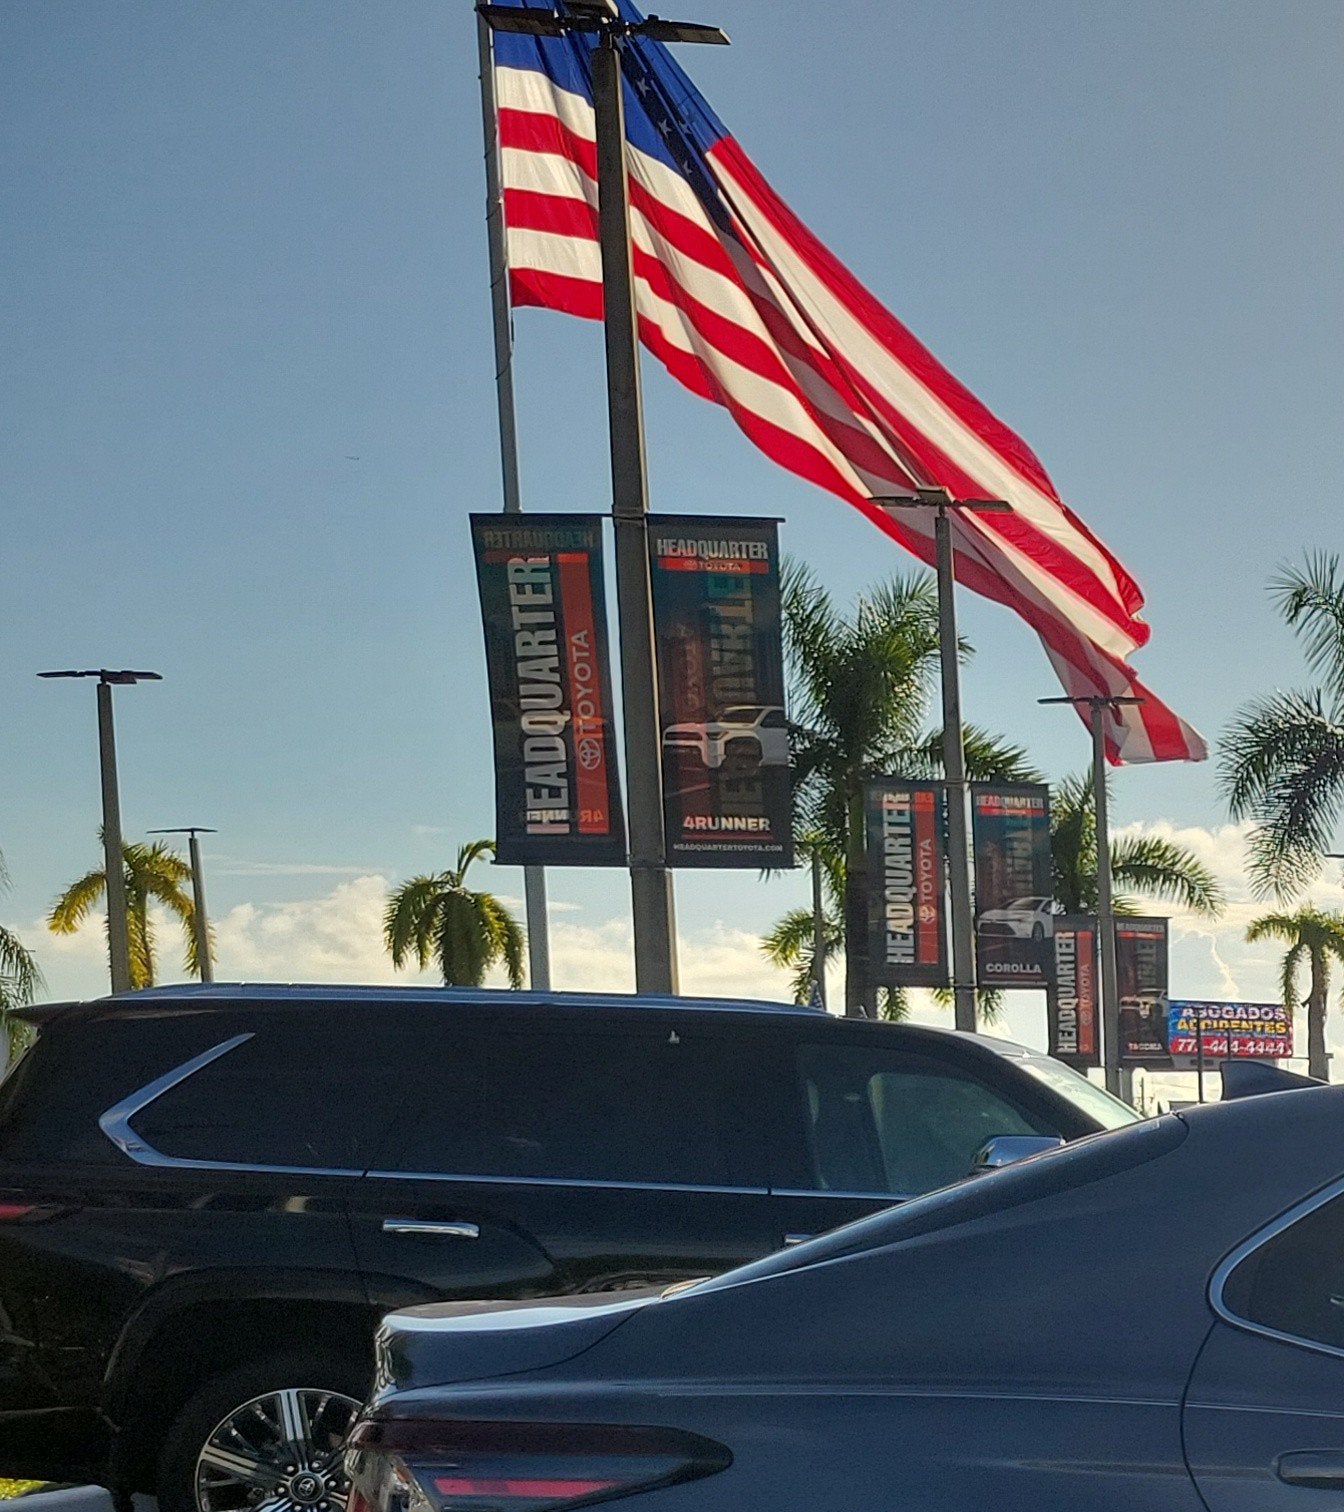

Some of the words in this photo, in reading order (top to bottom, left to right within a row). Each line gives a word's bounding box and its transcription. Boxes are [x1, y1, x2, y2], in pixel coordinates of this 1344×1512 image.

[657, 538, 768, 560] HEADQUARTER
[507, 555, 571, 834] HEADQUARTER
[571, 629, 597, 735] TOYOTA
[683, 815, 771, 831] 4RUNNER
[883, 792, 917, 964] HEADQUARTER
[919, 838, 933, 904] TOYOTA
[985, 963, 1042, 974] COROLLA
[1054, 931, 1078, 1054] HEADQUARTER
[1177, 1018, 1287, 1033] ACCIDENTES
[1178, 1039, 1285, 1054] 77-444-4444
